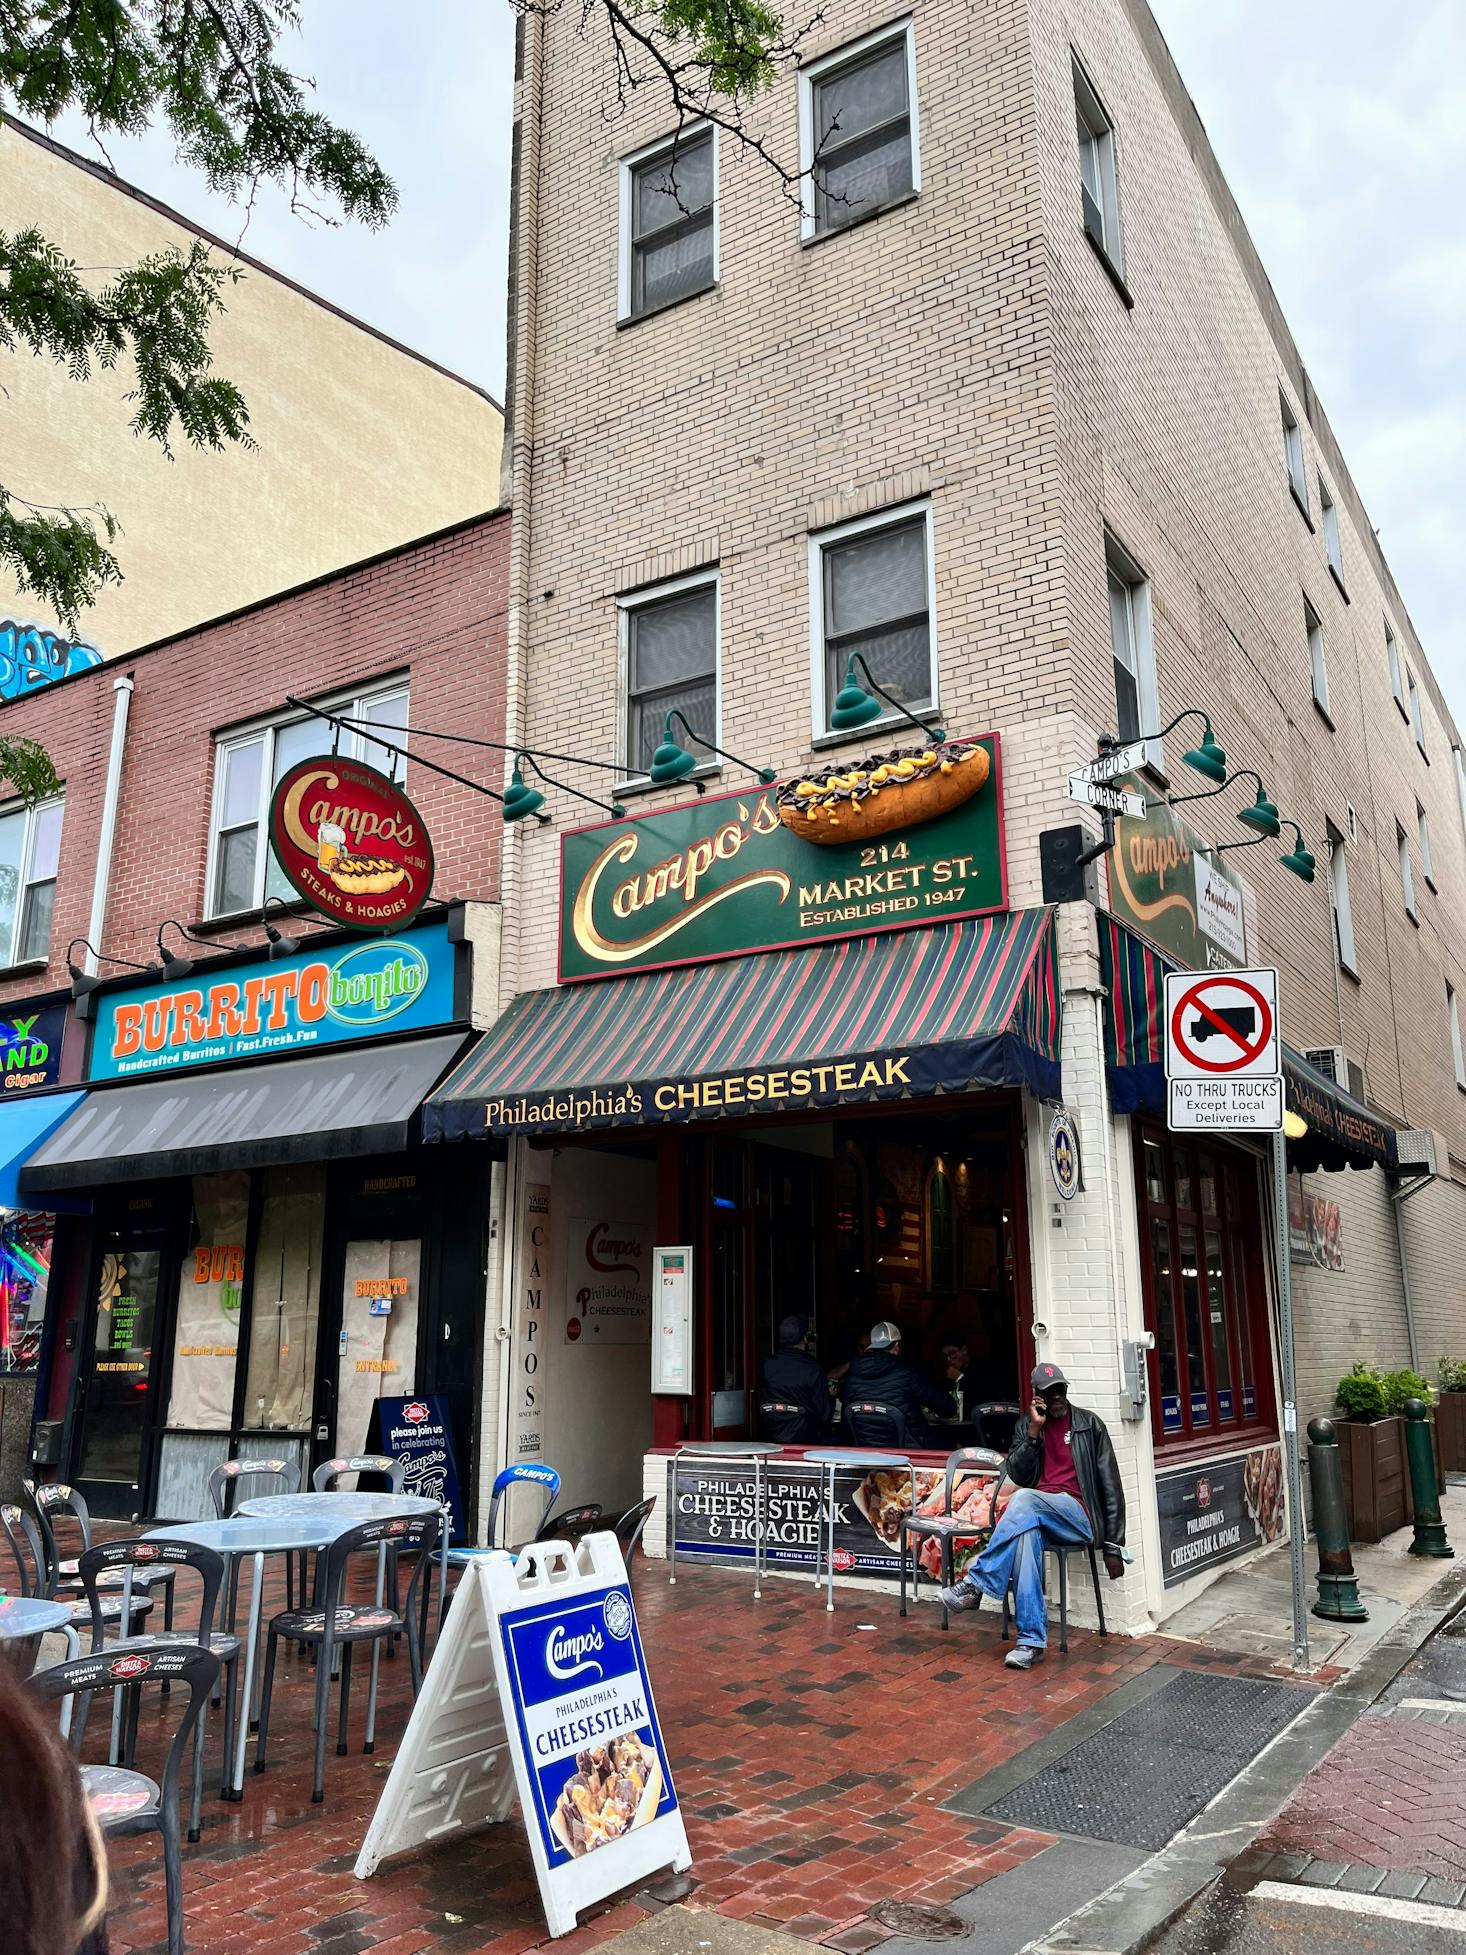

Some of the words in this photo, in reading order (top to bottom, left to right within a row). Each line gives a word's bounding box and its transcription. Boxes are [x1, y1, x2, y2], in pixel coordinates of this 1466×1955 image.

[342, 770, 389, 799] ORIGINAL
[1088, 784, 1129, 812] CORNER
[284, 771, 416, 860] Campo's
[860, 841, 910, 867] 214
[573, 793, 790, 961] Campo's
[799, 864, 926, 907] MARKET
[932, 854, 978, 883] ST.
[300, 868, 342, 908] STEAKS
[345, 901, 353, 914] &
[358, 899, 407, 918] HOAGIES
[800, 895, 918, 927] ESTABLISHED
[924, 887, 965, 906] 1947
[112, 963, 330, 1058] BURRITO
[331, 957, 421, 1011] bonito
[118, 1051, 179, 1073] Handcrafted
[182, 1045, 226, 1062] Burritos
[4, 1071, 47, 1088] Cigar
[484, 1082, 643, 1127] Philadelphia's
[654, 1055, 911, 1111] CHEESESTEAK
[1175, 1083, 1192, 1097] NO
[1198, 1083, 1227, 1097] THRU
[1231, 1083, 1277, 1097] TRUCKS
[1186, 1100, 1227, 1111] Except
[1232, 1100, 1264, 1110] Local
[1195, 1113, 1256, 1123] Deliveries
[364, 1175, 416, 1192] HANDCRAFTED
[585, 1222, 643, 1274] Campo's
[354, 1277, 408, 1297] BURRITO
[590, 1306, 647, 1317] CHEESESTEAK
[116, 1318, 134, 1328] TACOS
[391, 1427, 417, 1440] please
[418, 1426, 432, 1438] join
[433, 1425, 443, 1433] us
[519, 1433, 541, 1444] YARDS
[392, 1440, 400, 1450] in
[401, 1436, 446, 1450] celebrating
[513, 1467, 555, 1482] CAMPO'S
[679, 1494, 851, 1525] CHEESESTEAK
[708, 1516, 722, 1538] &
[729, 1518, 820, 1545] HOAGIE
[1187, 1509, 1225, 1535] PHILADELPHIA'S
[103, 1548, 127, 1556] PREMIUM
[162, 1552, 187, 1560] CHEESES
[775, 1551, 803, 1559] PREMIUM
[1170, 1537, 1213, 1569] CHEESESTEAK
[1213, 1533, 1219, 1552] &
[1219, 1525, 1240, 1549] HOAGIE
[108, 1553, 124, 1561] MEATS
[858, 1557, 885, 1566] ARTISAN
[158, 1655, 186, 1663] ARTISAN
[546, 1624, 605, 1680] Campo's
[64, 1664, 104, 1679] PREMIUM
[153, 1663, 183, 1671] CHEESES
[71, 1673, 97, 1685] MEATS
[556, 1687, 618, 1719] PHILADELPHIA'S
[536, 1698, 645, 1756] CHEESESTEAK
